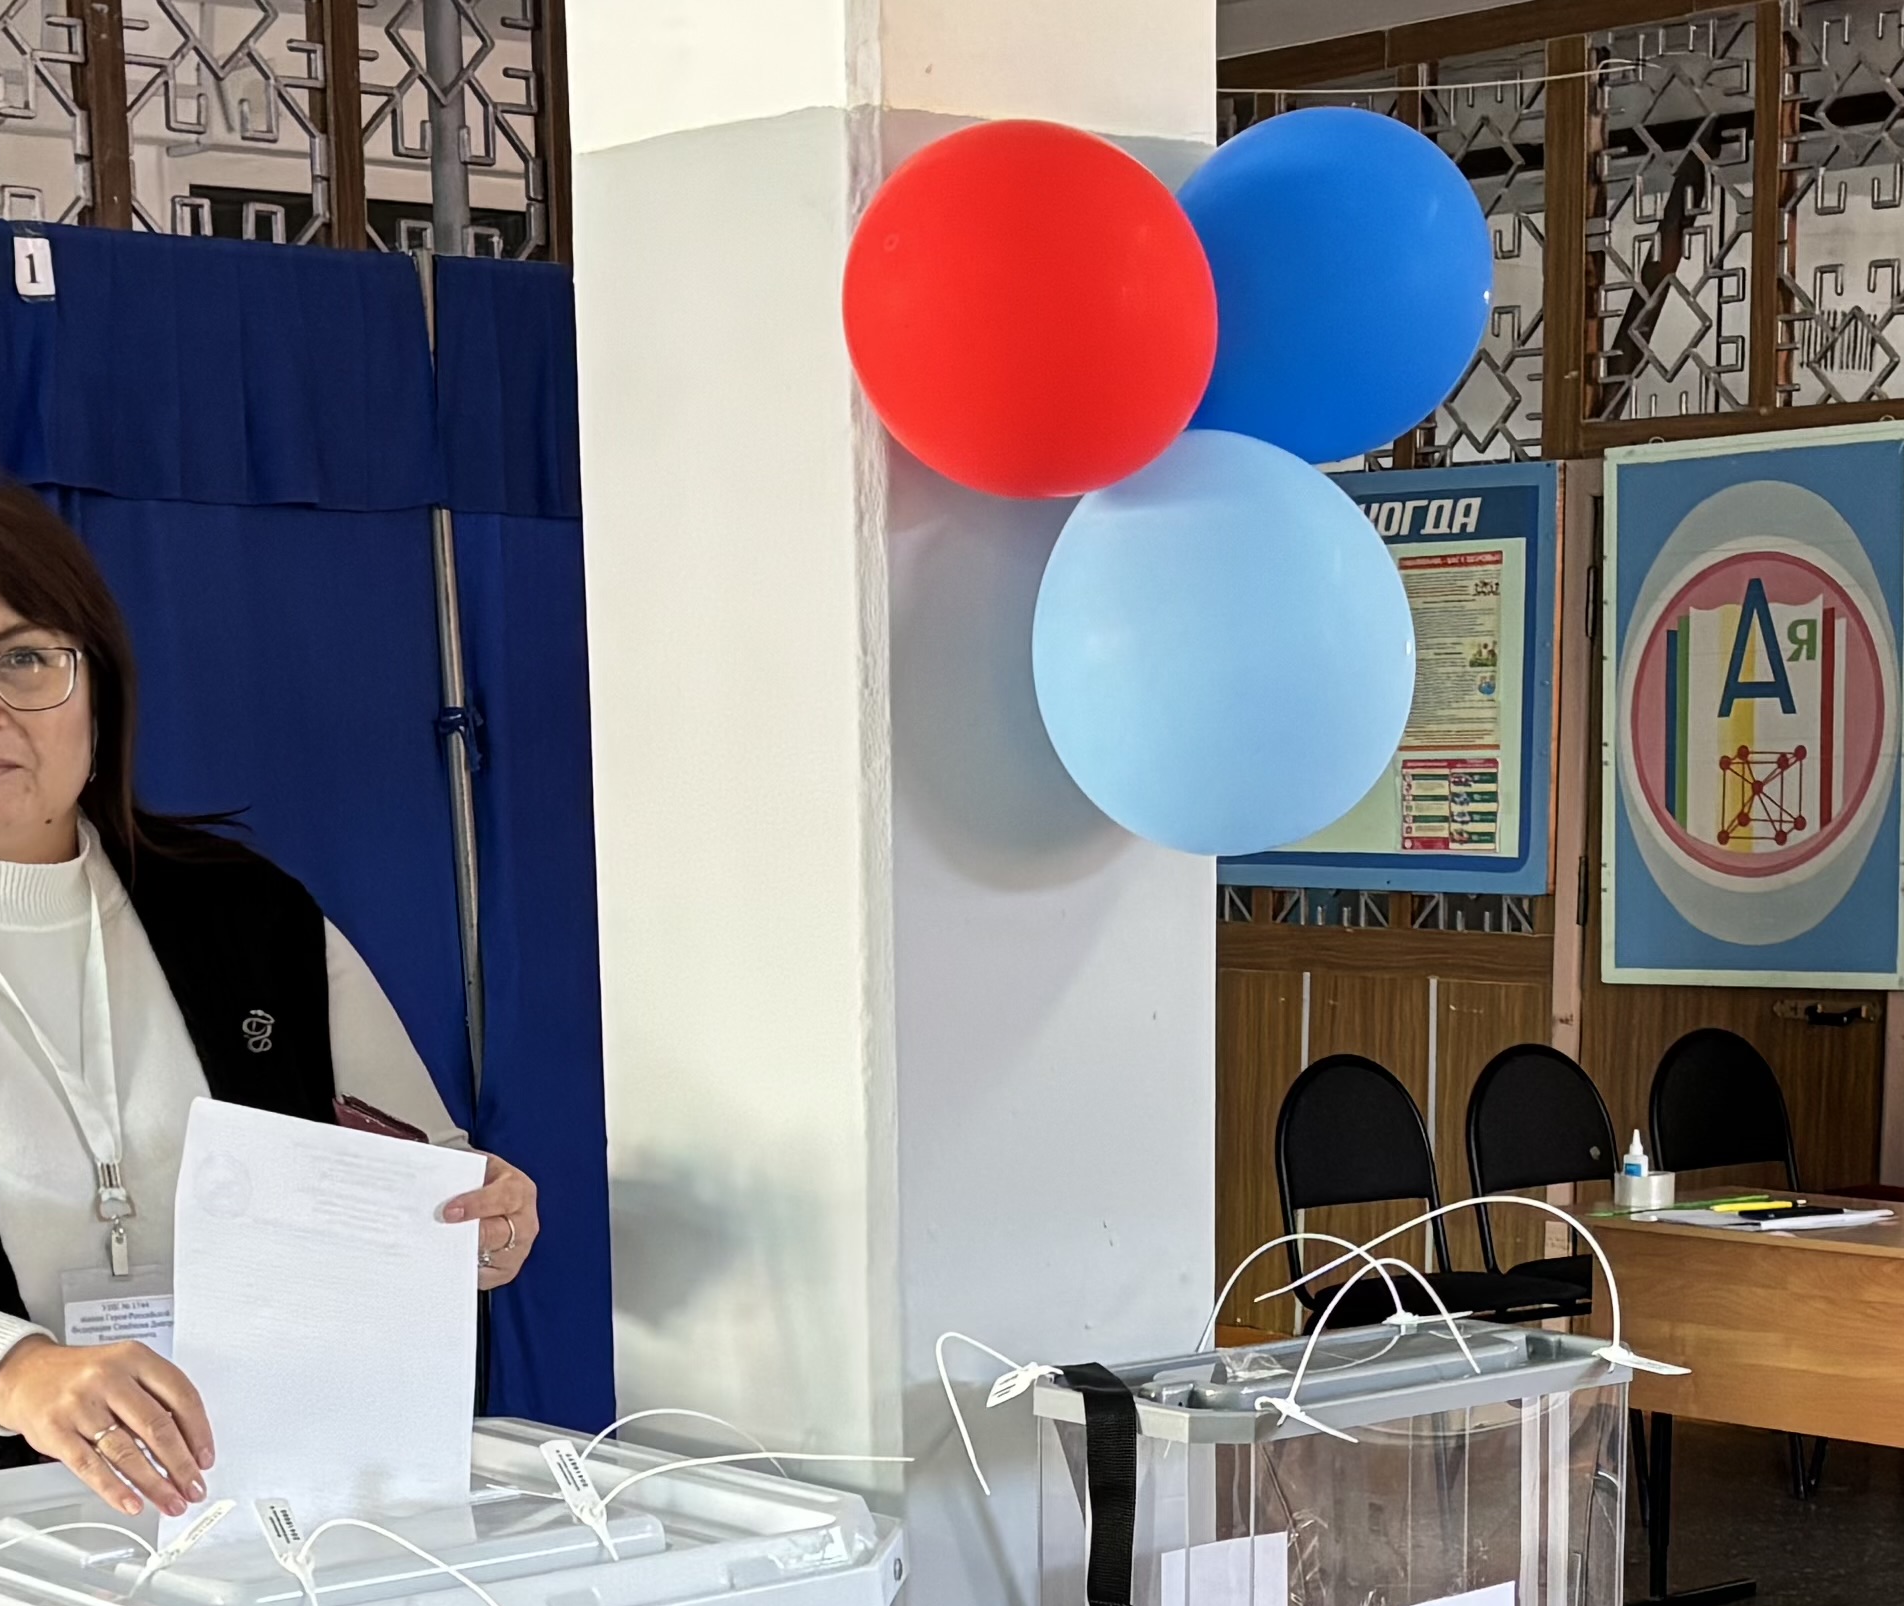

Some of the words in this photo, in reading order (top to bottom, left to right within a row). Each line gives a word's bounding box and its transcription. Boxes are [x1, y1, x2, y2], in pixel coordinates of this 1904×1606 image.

[25, 253, 41, 283] 1
[1717, 578, 1797, 718] А
[1786, 618, 1818, 662] Я
